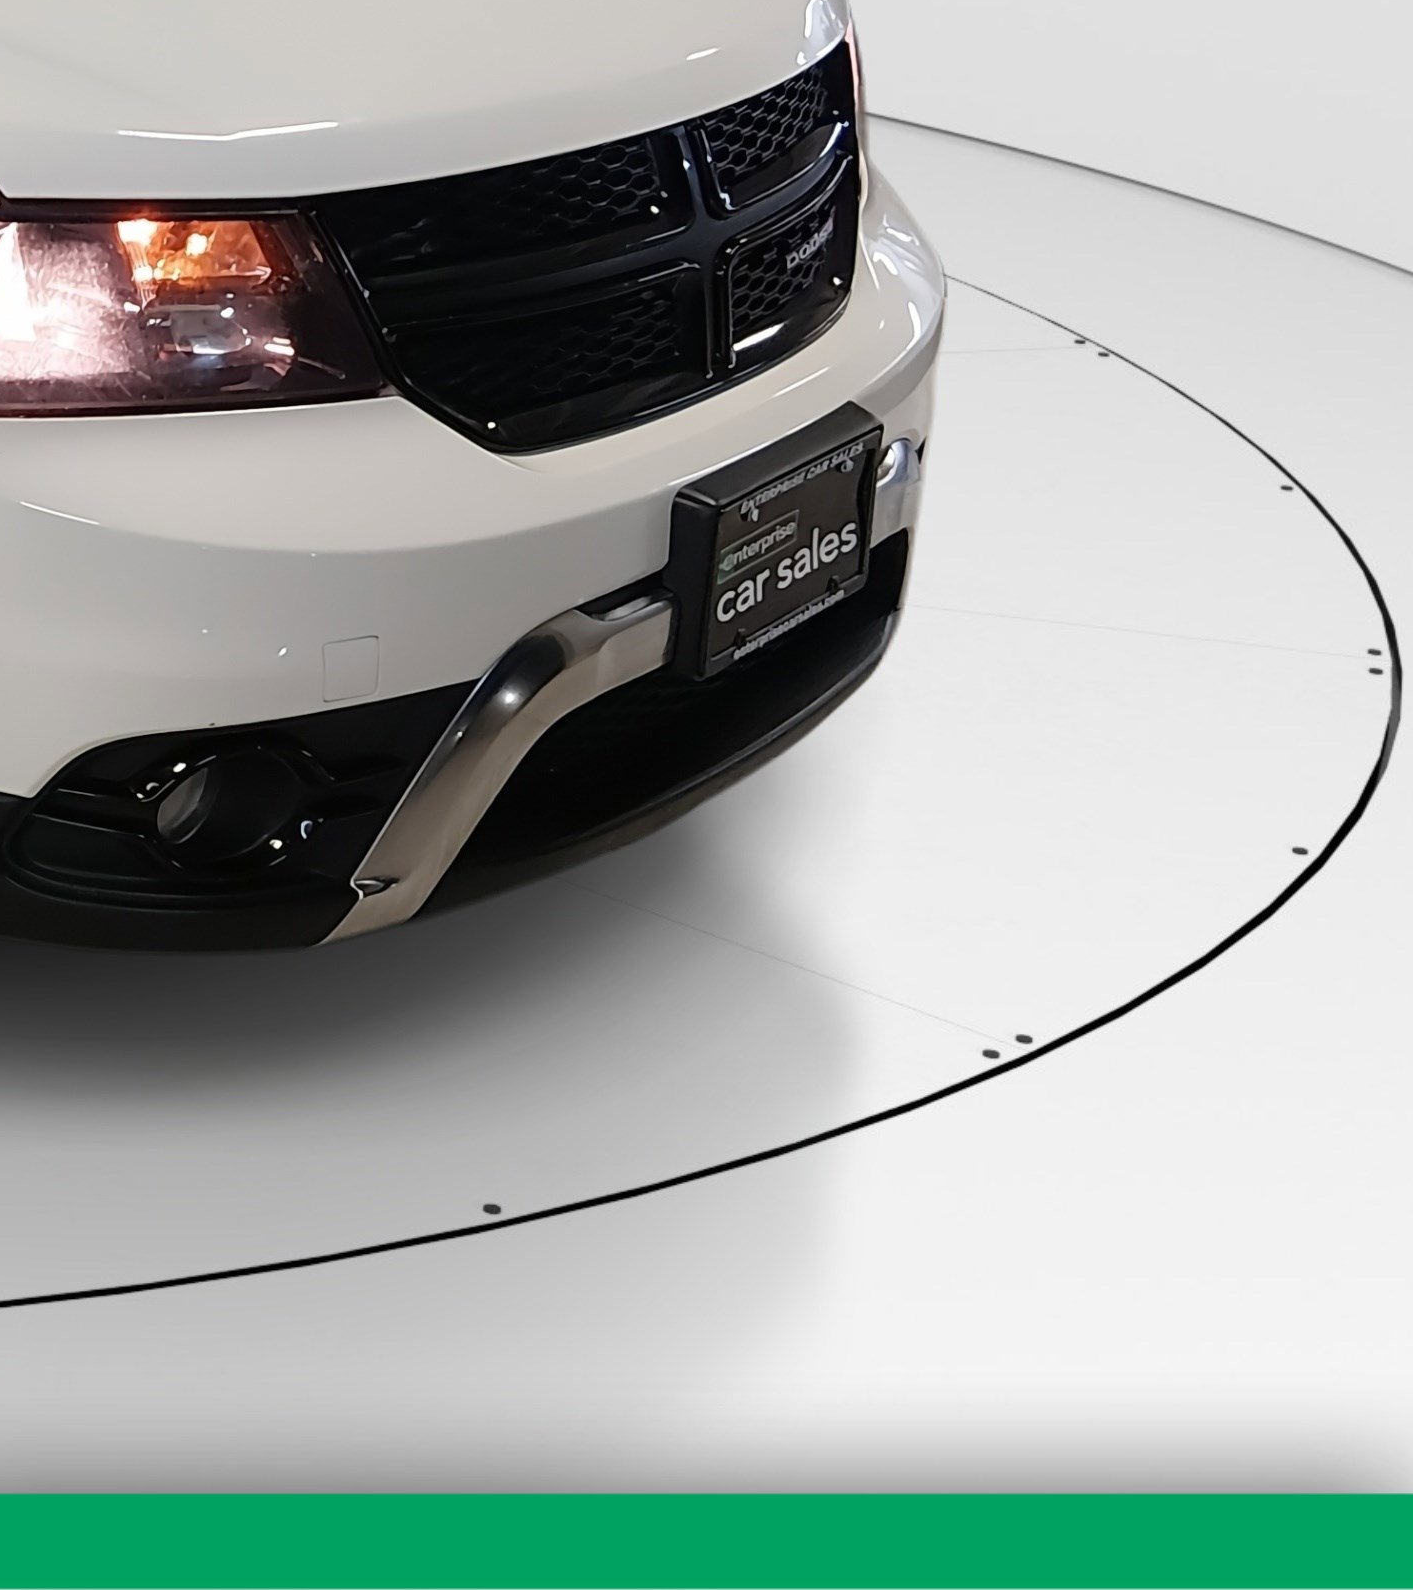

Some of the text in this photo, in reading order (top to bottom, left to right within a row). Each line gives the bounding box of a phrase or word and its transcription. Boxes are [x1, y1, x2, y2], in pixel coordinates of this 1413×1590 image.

[716, 522, 858, 622] car sales
[718, 521, 798, 571] enterprise
